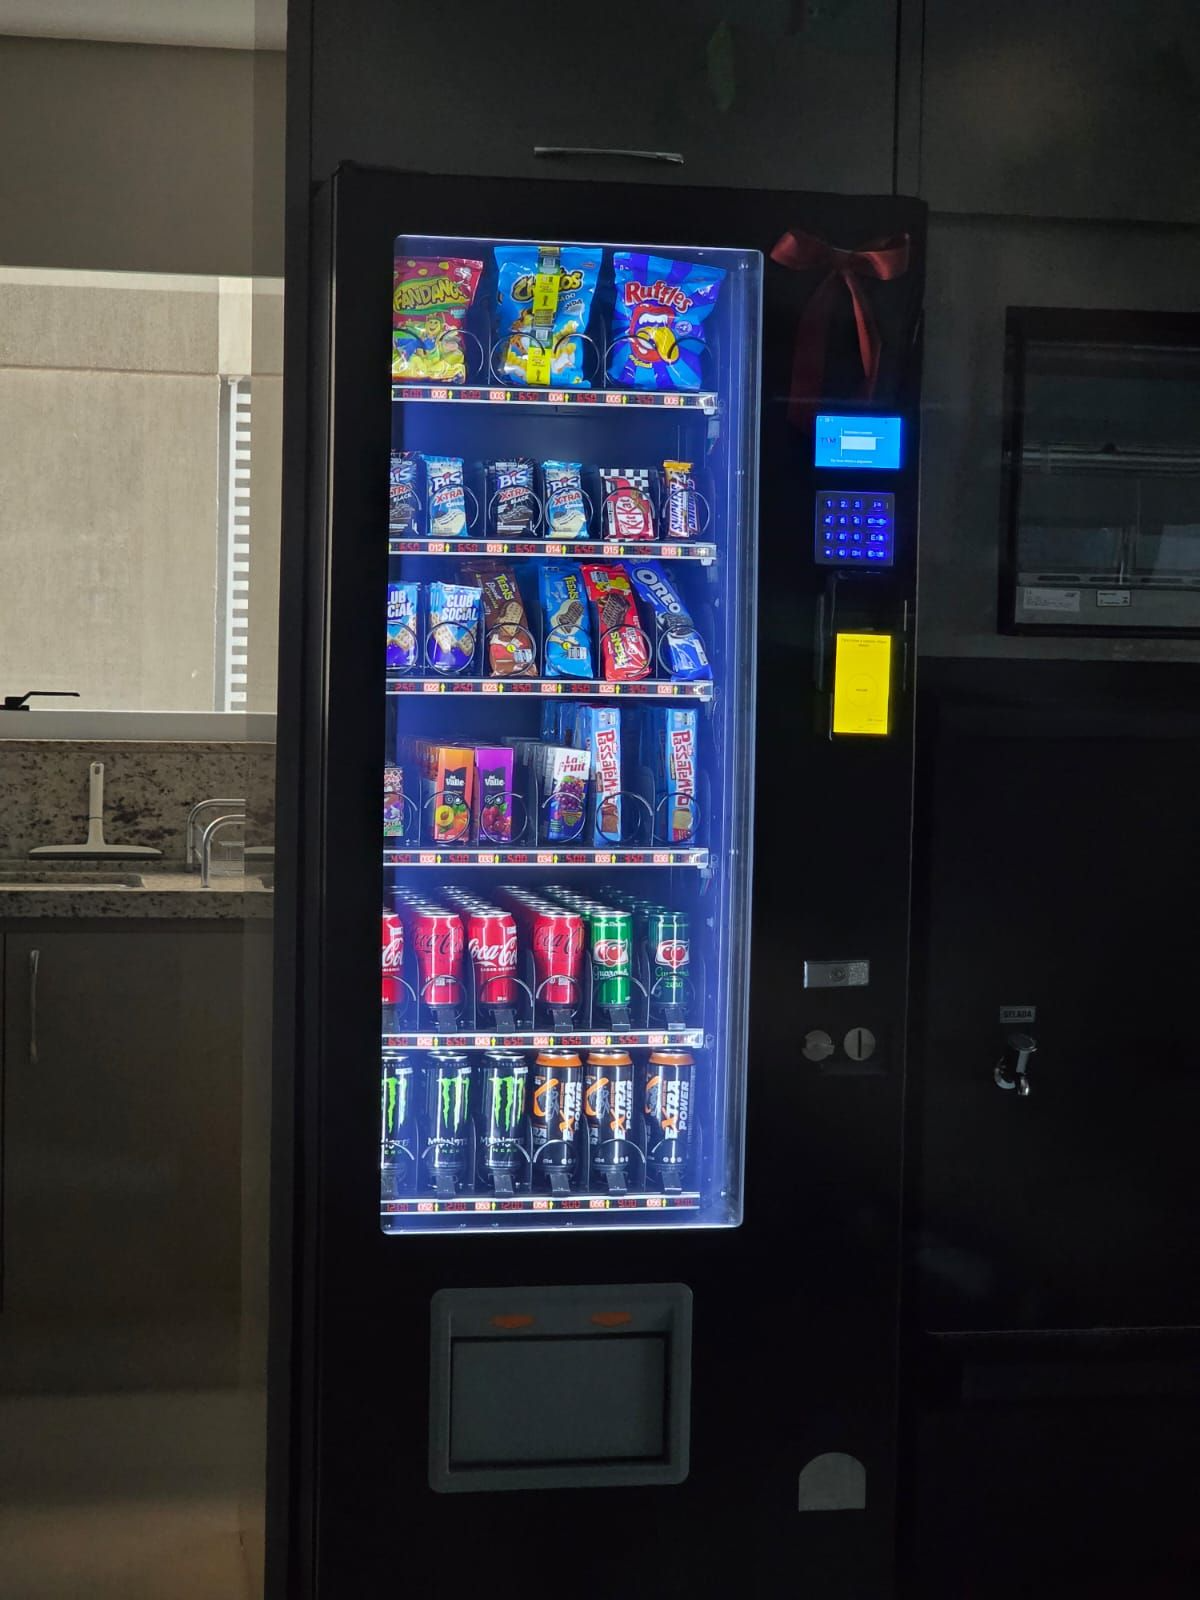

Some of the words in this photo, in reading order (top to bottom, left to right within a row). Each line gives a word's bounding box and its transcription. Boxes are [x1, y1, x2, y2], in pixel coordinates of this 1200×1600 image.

[625, 280, 693, 313] Ruffles
[432, 389, 448, 399] 002
[490, 391, 505, 400] 003
[436, 488, 464, 504] XTRA
[553, 491, 581, 506] XTRA
[428, 543, 444, 552] 012
[487, 543, 502, 553] 013
[546, 544, 561, 554] 014
[603, 544, 619, 554] 015
[636, 569, 681, 613] OREO
[446, 594, 474, 607] CLUB
[446, 778, 465, 787] Valle
[485, 778, 504, 787] Valle
[559, 1081, 577, 1141] EXTRA
[609, 1080, 626, 1141] EXTRA
[625, 1080, 633, 1130] POWER
[661, 1080, 681, 1140] EXTRA
[678, 1081, 690, 1131] POWER
